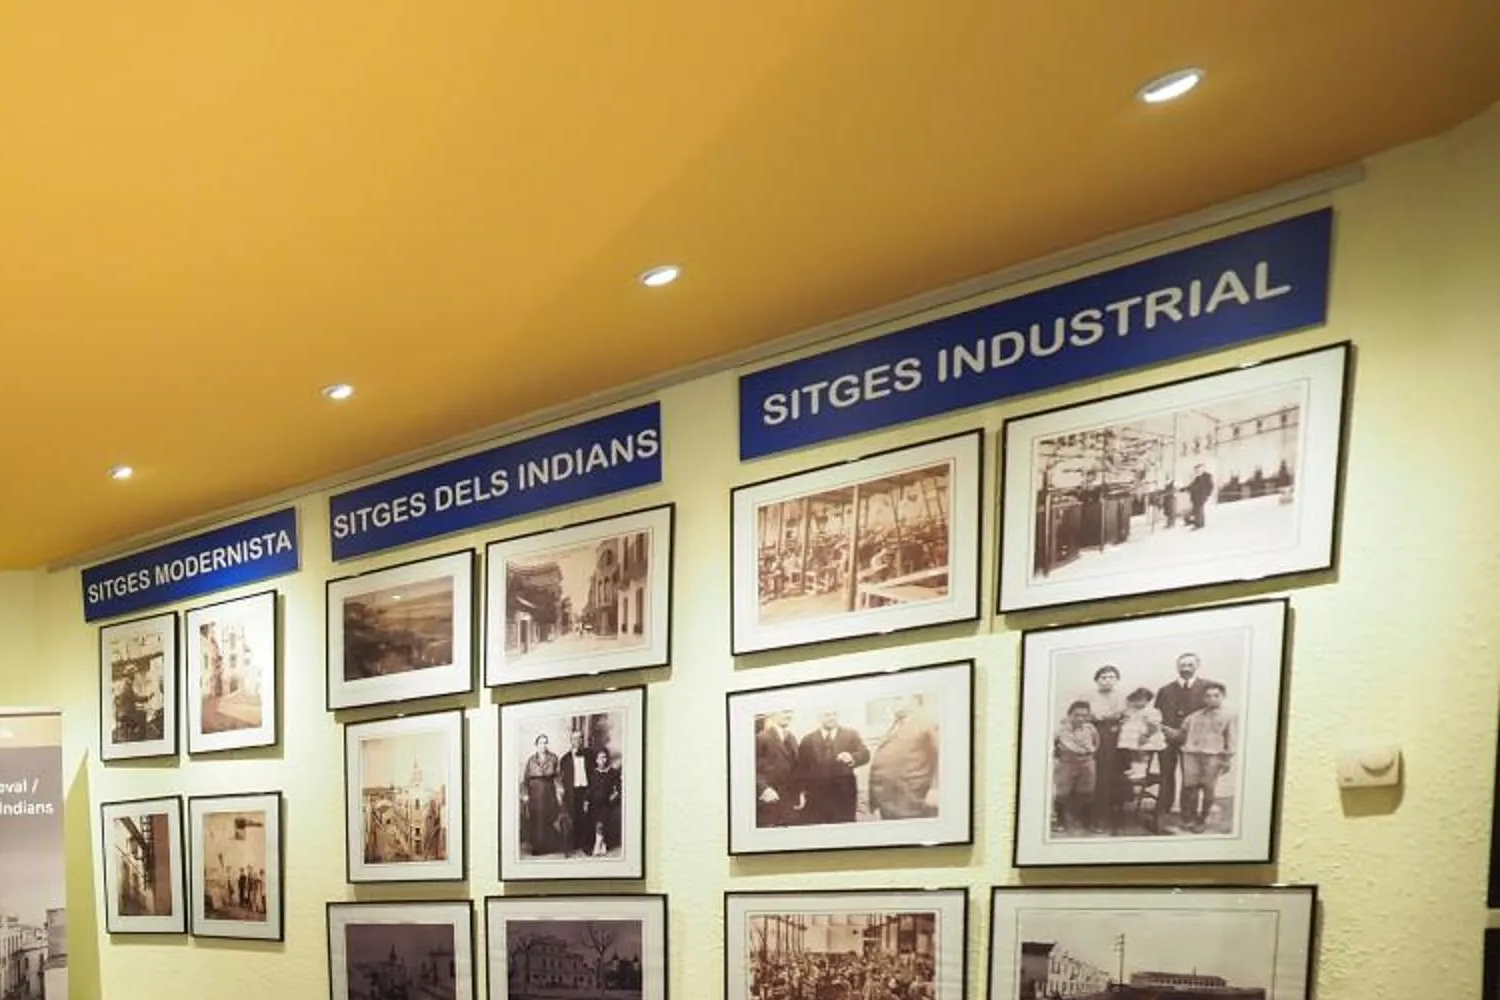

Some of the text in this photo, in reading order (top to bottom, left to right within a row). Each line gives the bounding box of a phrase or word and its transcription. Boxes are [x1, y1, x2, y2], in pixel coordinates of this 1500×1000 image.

[762, 261, 1291, 427] SITGES INDUSTRIAL
[332, 428, 659, 540] SITGES DELS INDIANS
[87, 531, 292, 604] SITGES MODERNISTA
